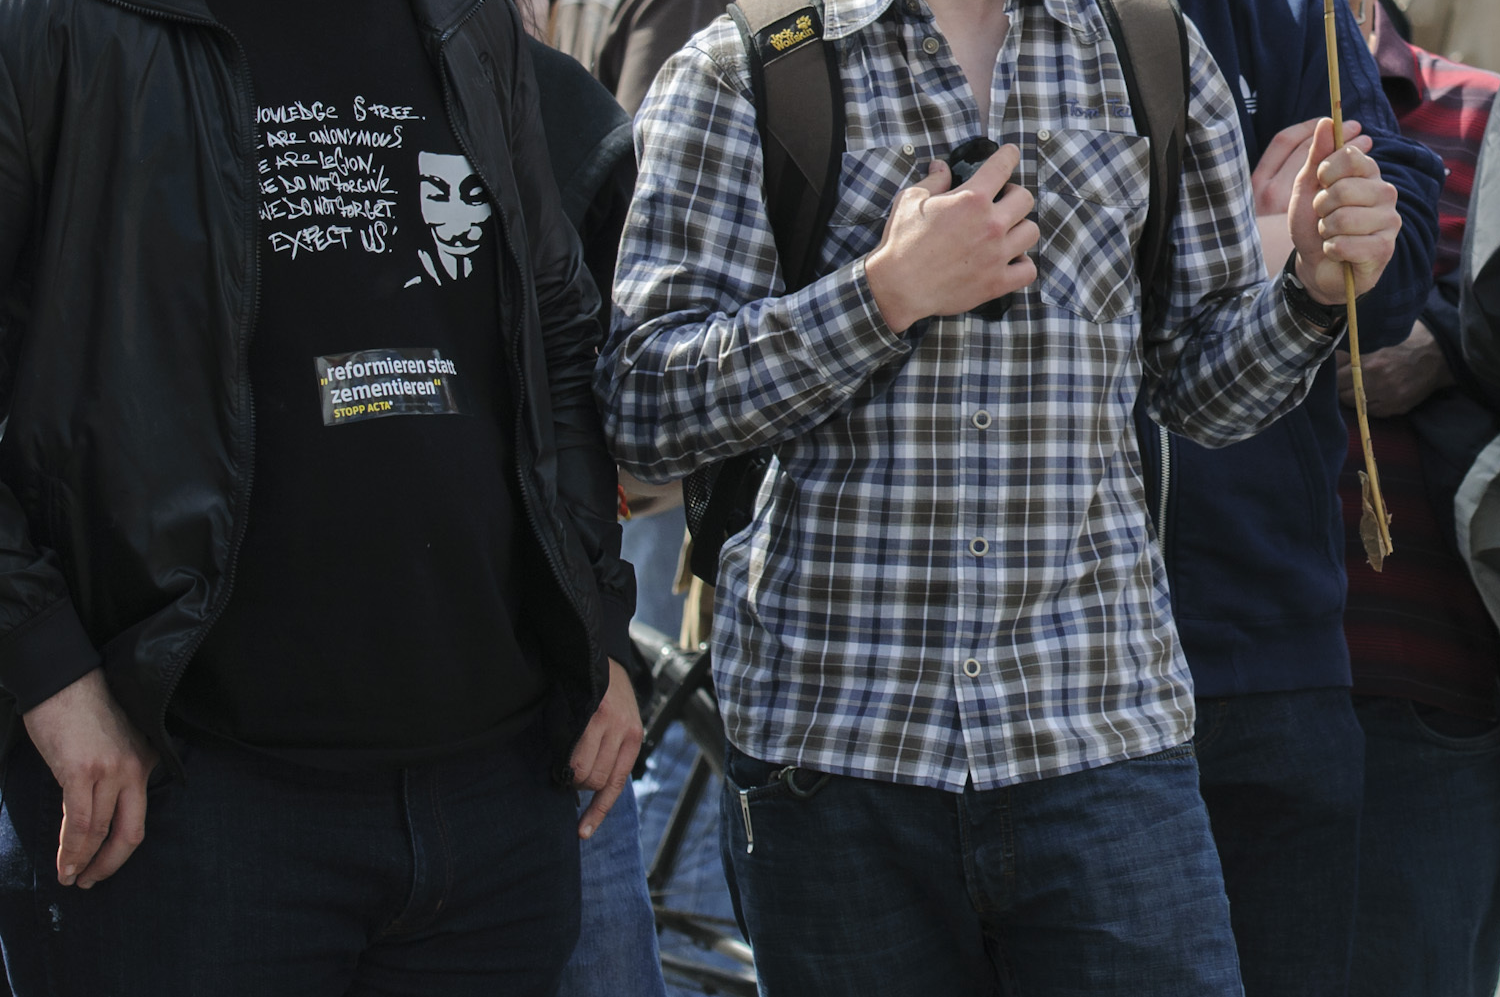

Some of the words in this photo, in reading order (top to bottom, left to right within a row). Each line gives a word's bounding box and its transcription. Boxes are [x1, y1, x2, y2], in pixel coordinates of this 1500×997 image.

[1066, 98, 1100, 119] Tom
[278, 175, 307, 194] DO
[309, 174, 332, 193] NOT
[281, 197, 312, 219] DO
[314, 195, 337, 215] NOT
[268, 225, 352, 260] EXPECT
[428, 358, 457, 375] statt
[333, 404, 365, 418] STOPP
